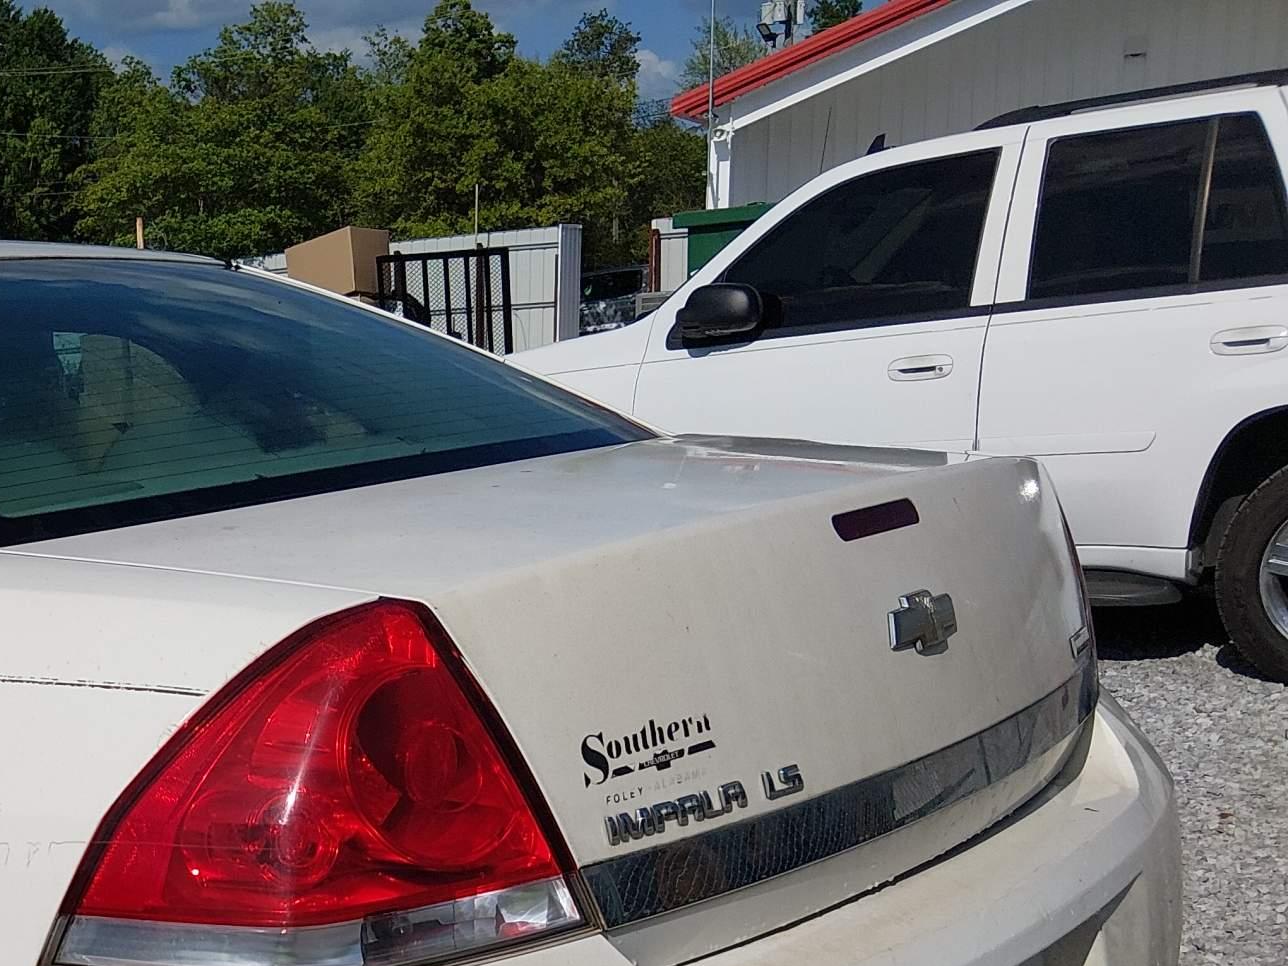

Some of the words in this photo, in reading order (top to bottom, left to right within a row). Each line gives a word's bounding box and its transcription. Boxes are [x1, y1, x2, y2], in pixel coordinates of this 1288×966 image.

[580, 713, 711, 789] Southern
[605, 780, 748, 847] IMPALA
[761, 764, 805, 801] LS
[606, 786, 644, 806] FOLEY
